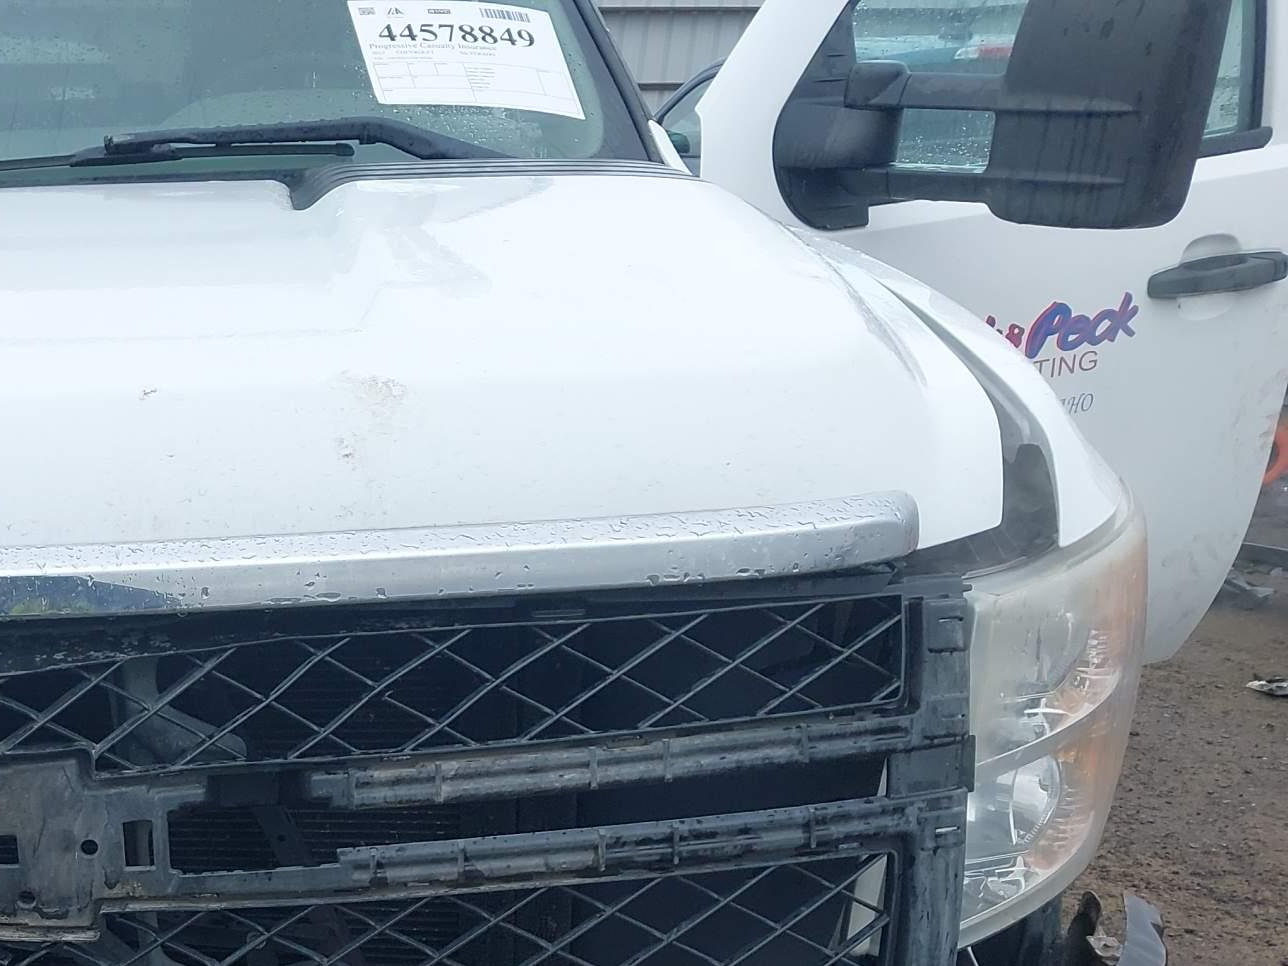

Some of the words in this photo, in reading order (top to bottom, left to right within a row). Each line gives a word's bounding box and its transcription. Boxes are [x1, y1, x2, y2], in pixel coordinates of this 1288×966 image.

[369, 42, 419, 50] Progressive
[378, 23, 535, 47] 44578849
[1033, 350, 1098, 378] TING
